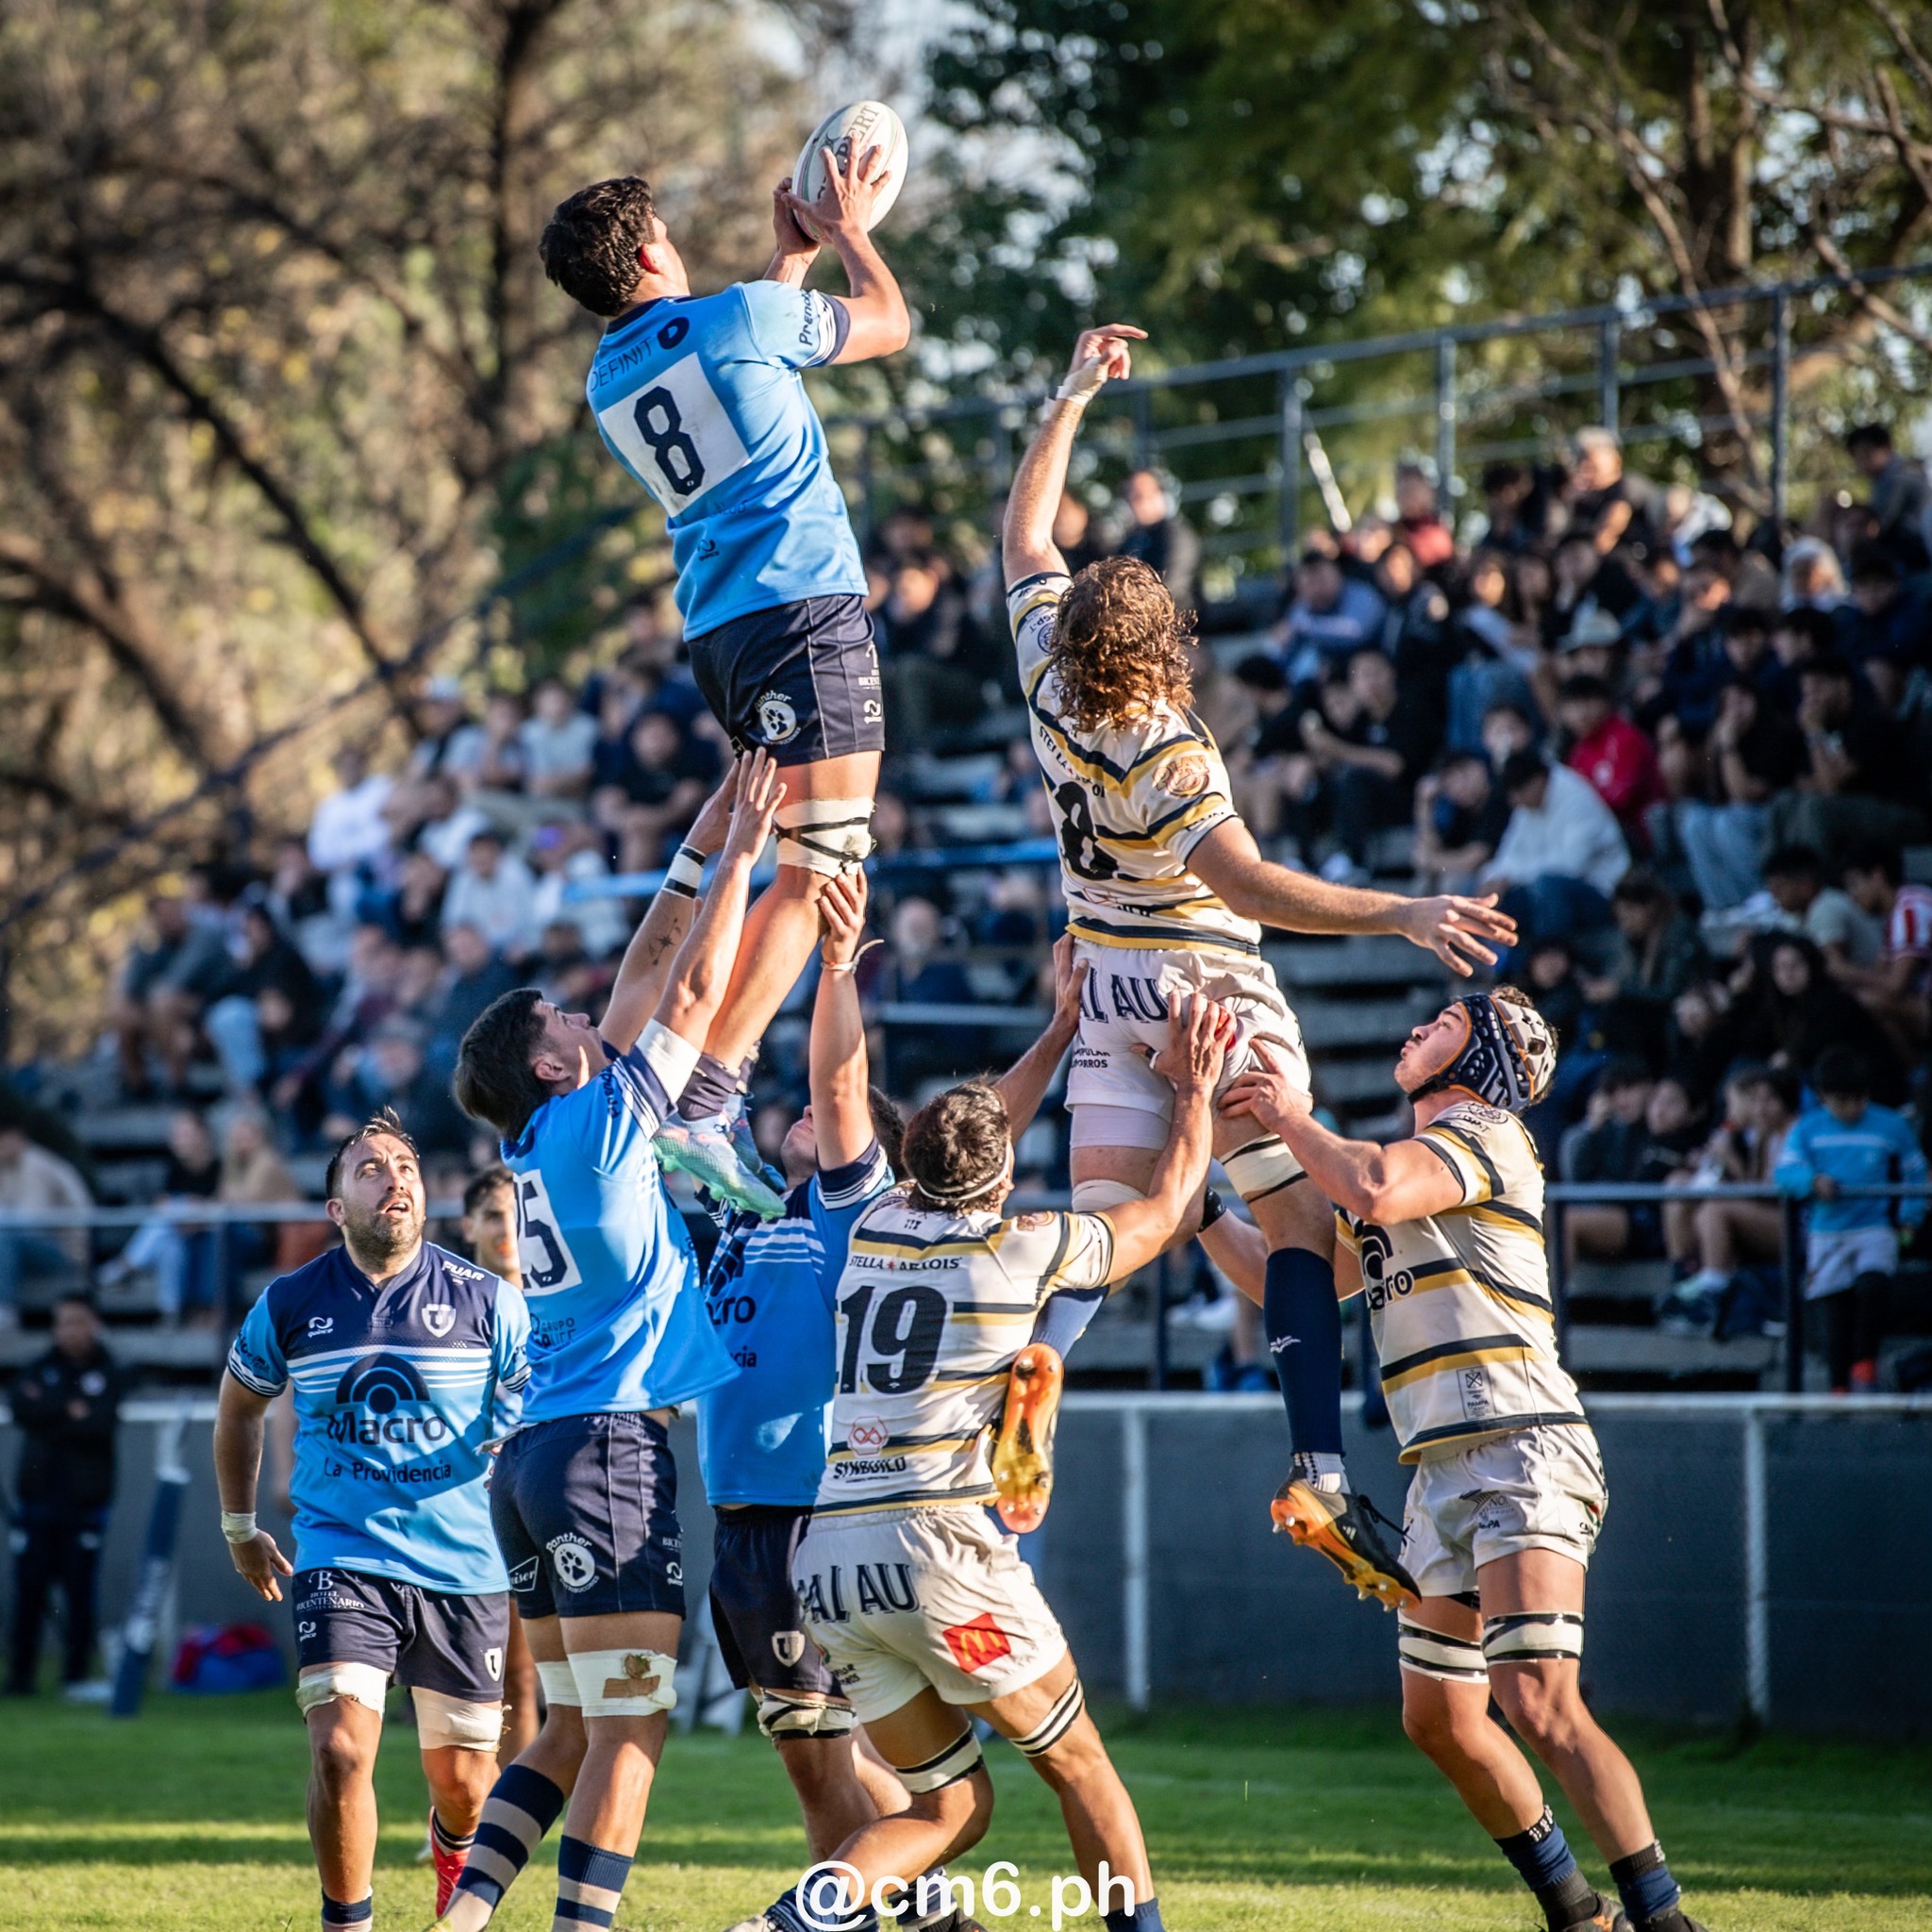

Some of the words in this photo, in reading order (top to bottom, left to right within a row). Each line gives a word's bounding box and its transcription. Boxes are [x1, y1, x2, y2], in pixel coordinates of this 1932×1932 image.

[633, 385, 706, 497] 8
[1054, 781, 1120, 882] 8
[1079, 966, 1170, 1024] LAU
[441, 1259, 485, 1281] FUAR
[849, 1255, 884, 1270] STELLA
[541, 1317, 575, 1332] GRUPO
[705, 1295, 757, 1325] cro
[840, 1285, 947, 1394] 19
[730, 1344, 758, 1368] cia
[326, 1410, 446, 1445] Macro
[324, 1457, 341, 1478] La
[351, 1458, 452, 1484] Providencia
